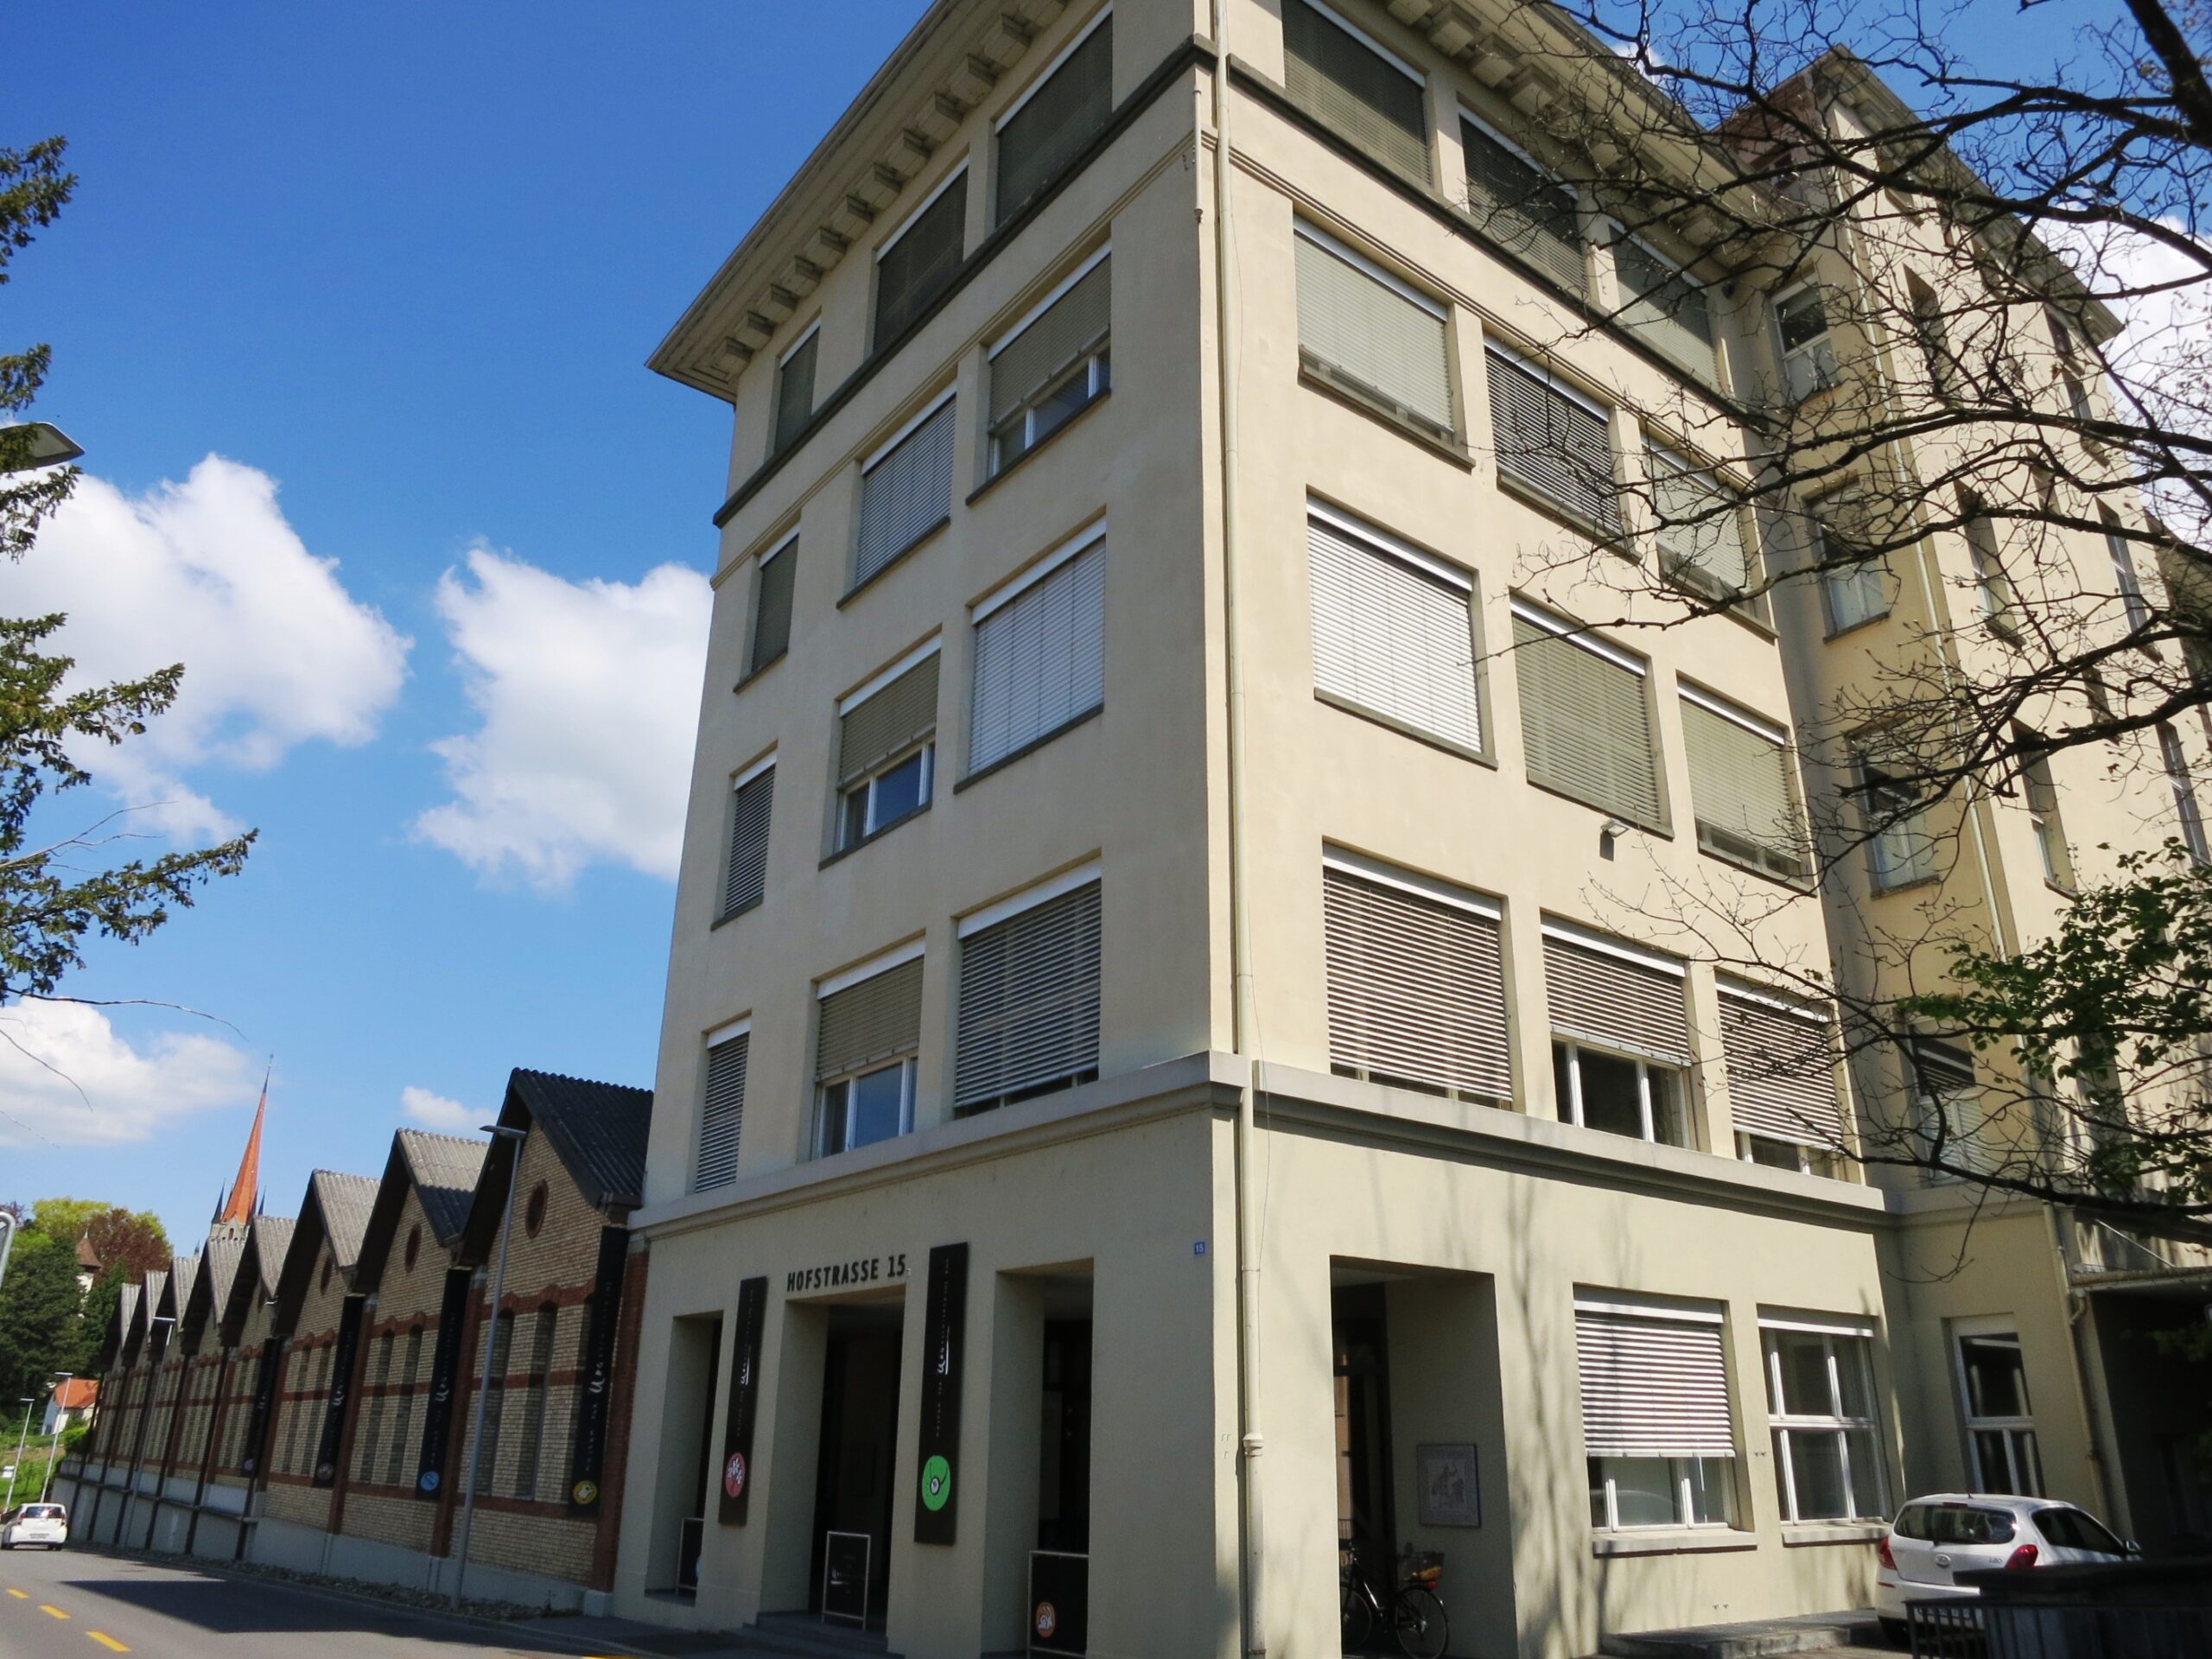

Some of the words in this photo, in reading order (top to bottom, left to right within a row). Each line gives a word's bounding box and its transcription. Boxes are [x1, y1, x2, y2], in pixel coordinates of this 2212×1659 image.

[1195, 1243, 1204, 1253] 15
[786, 1258, 880, 1292] HOFSTRASSE
[887, 1254, 906, 1278] 15
